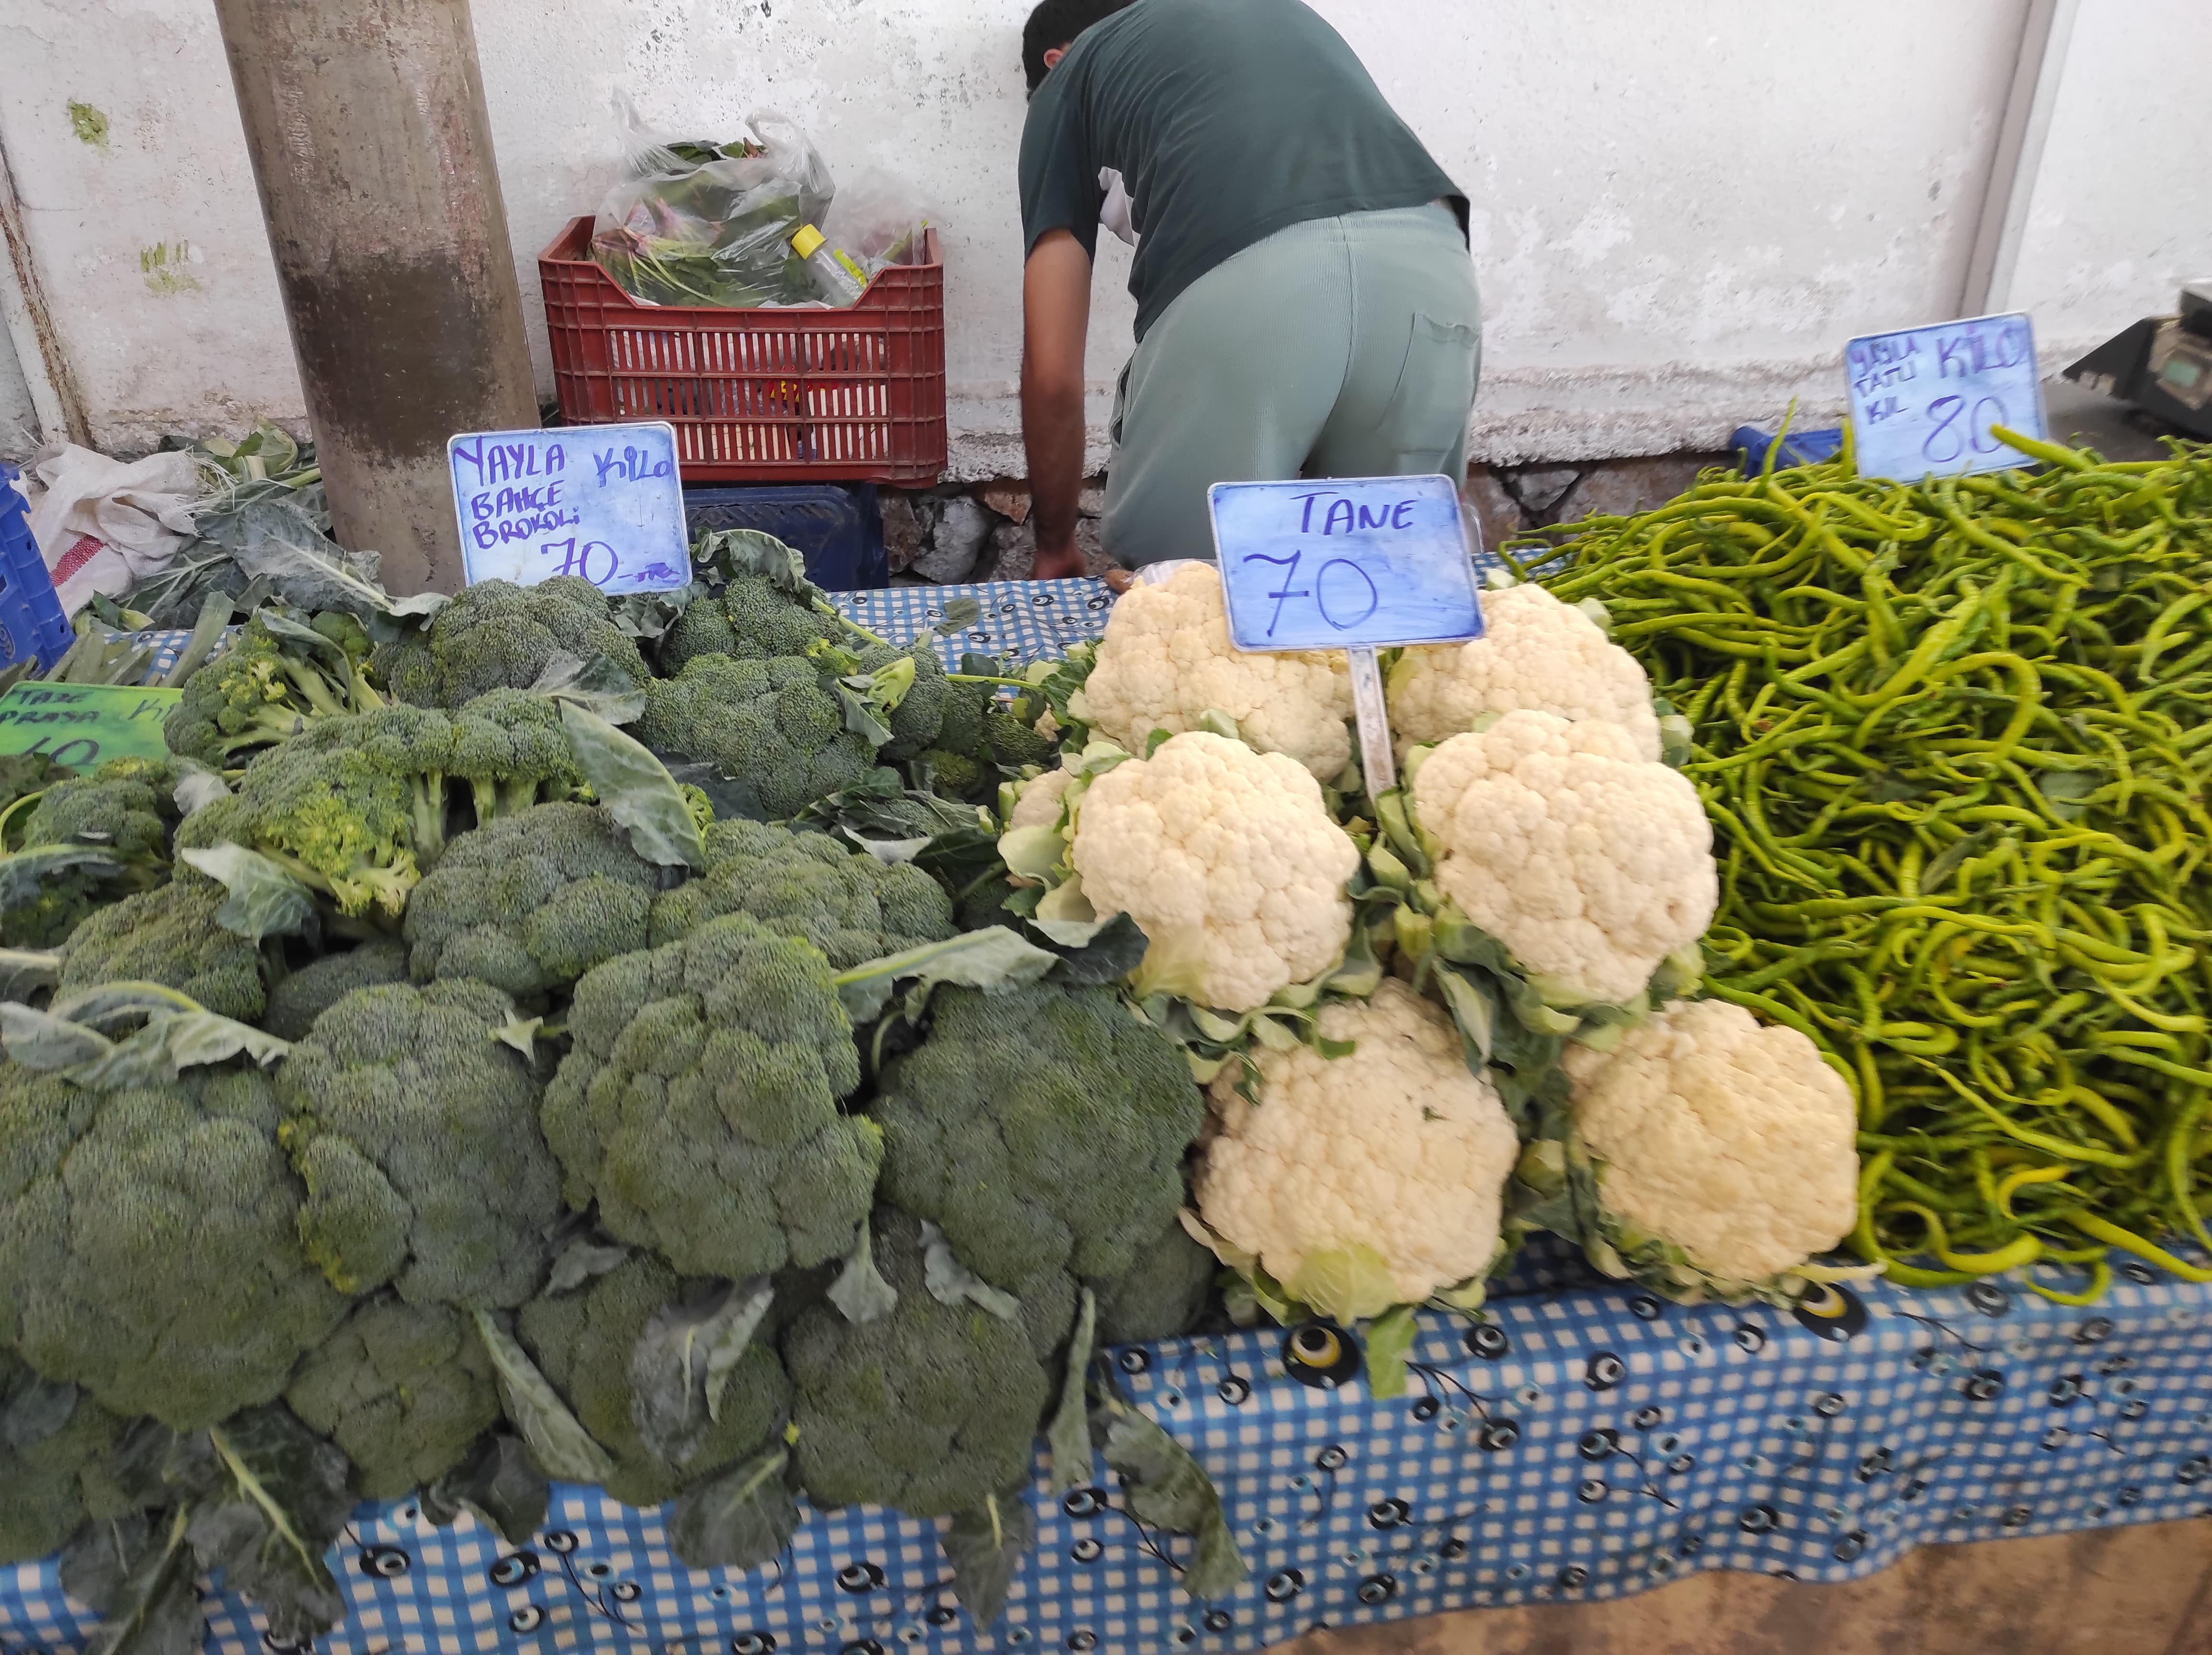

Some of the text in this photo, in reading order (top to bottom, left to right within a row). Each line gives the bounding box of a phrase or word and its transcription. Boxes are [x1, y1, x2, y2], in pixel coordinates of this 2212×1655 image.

[1923, 395, 2009, 462] 80
[455, 436, 565, 486] YAYLA
[1290, 491, 1418, 535] TANE
[540, 537, 619, 586] 70
[1243, 549, 1378, 637] 70
